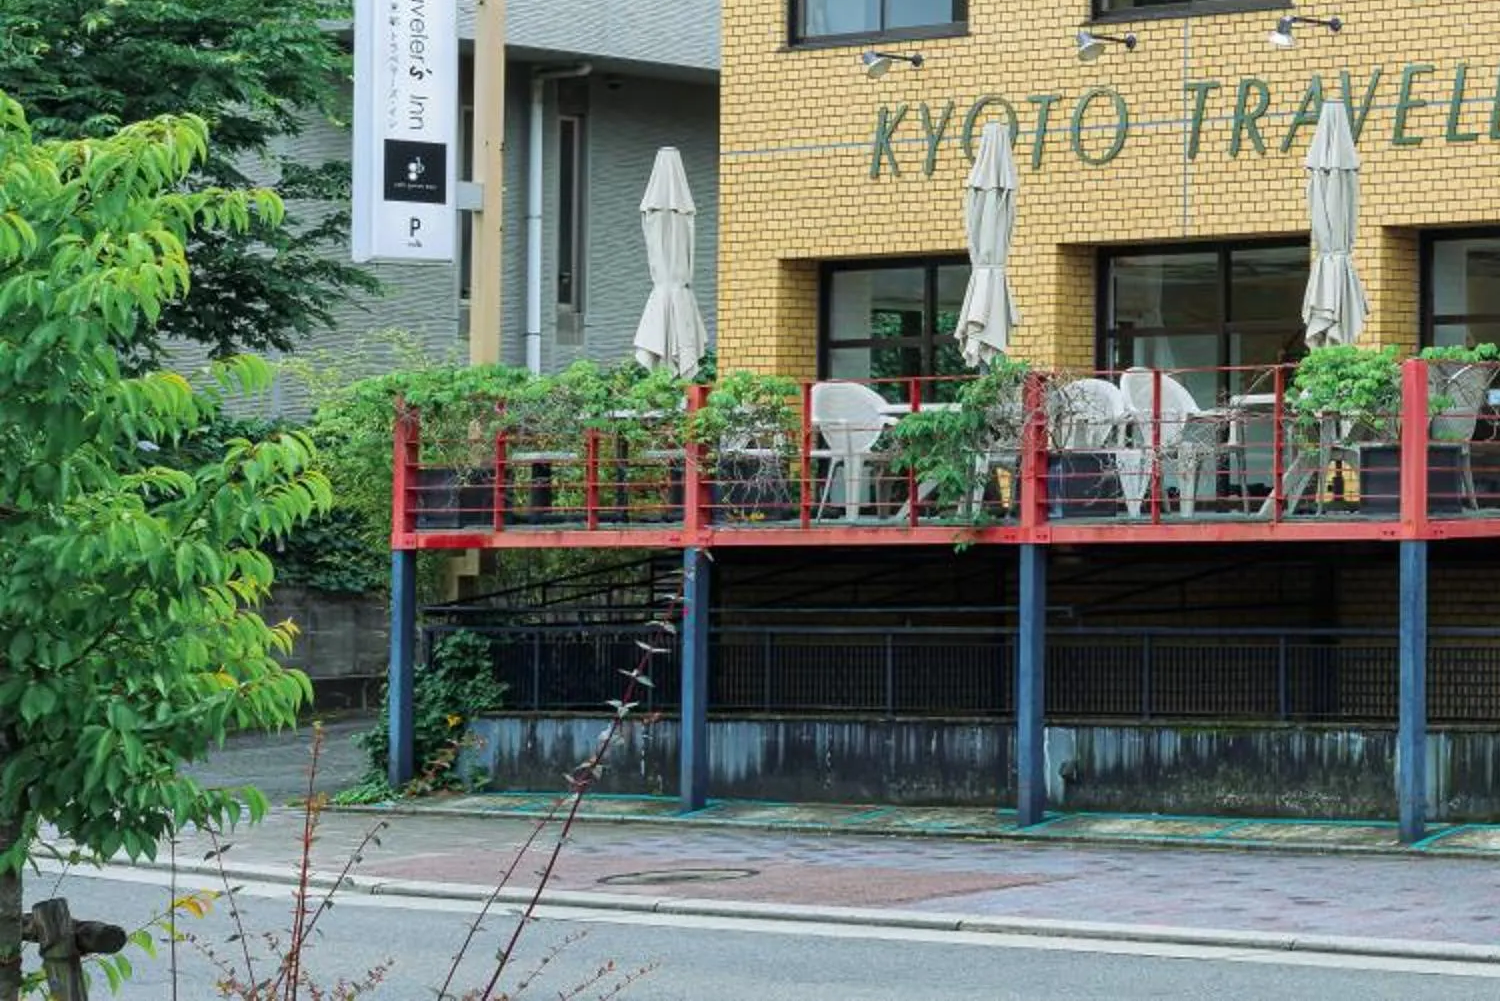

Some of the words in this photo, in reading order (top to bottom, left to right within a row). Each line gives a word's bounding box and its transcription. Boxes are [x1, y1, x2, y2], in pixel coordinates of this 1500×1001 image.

[408, 94, 430, 130] Inn
[869, 86, 1129, 180] KYOTO
[409, 217, 421, 238] P
